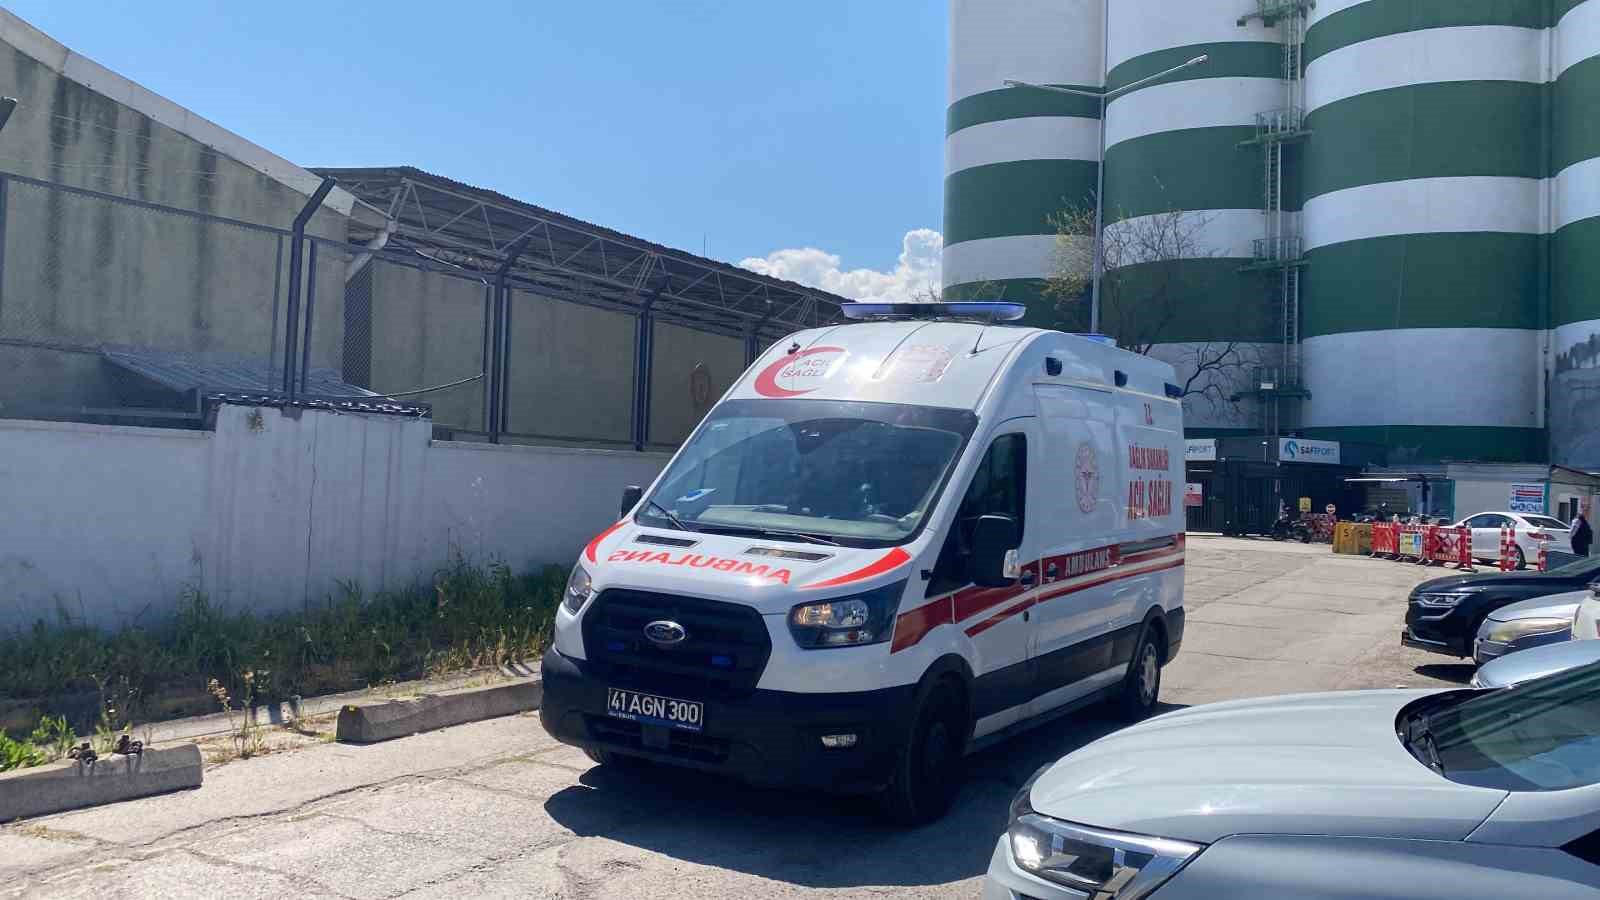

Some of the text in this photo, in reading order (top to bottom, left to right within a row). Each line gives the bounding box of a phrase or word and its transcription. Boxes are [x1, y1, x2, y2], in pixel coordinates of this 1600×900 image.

[611, 691, 626, 711] 41
[628, 694, 666, 718] AGN
[668, 701, 699, 723] 300
